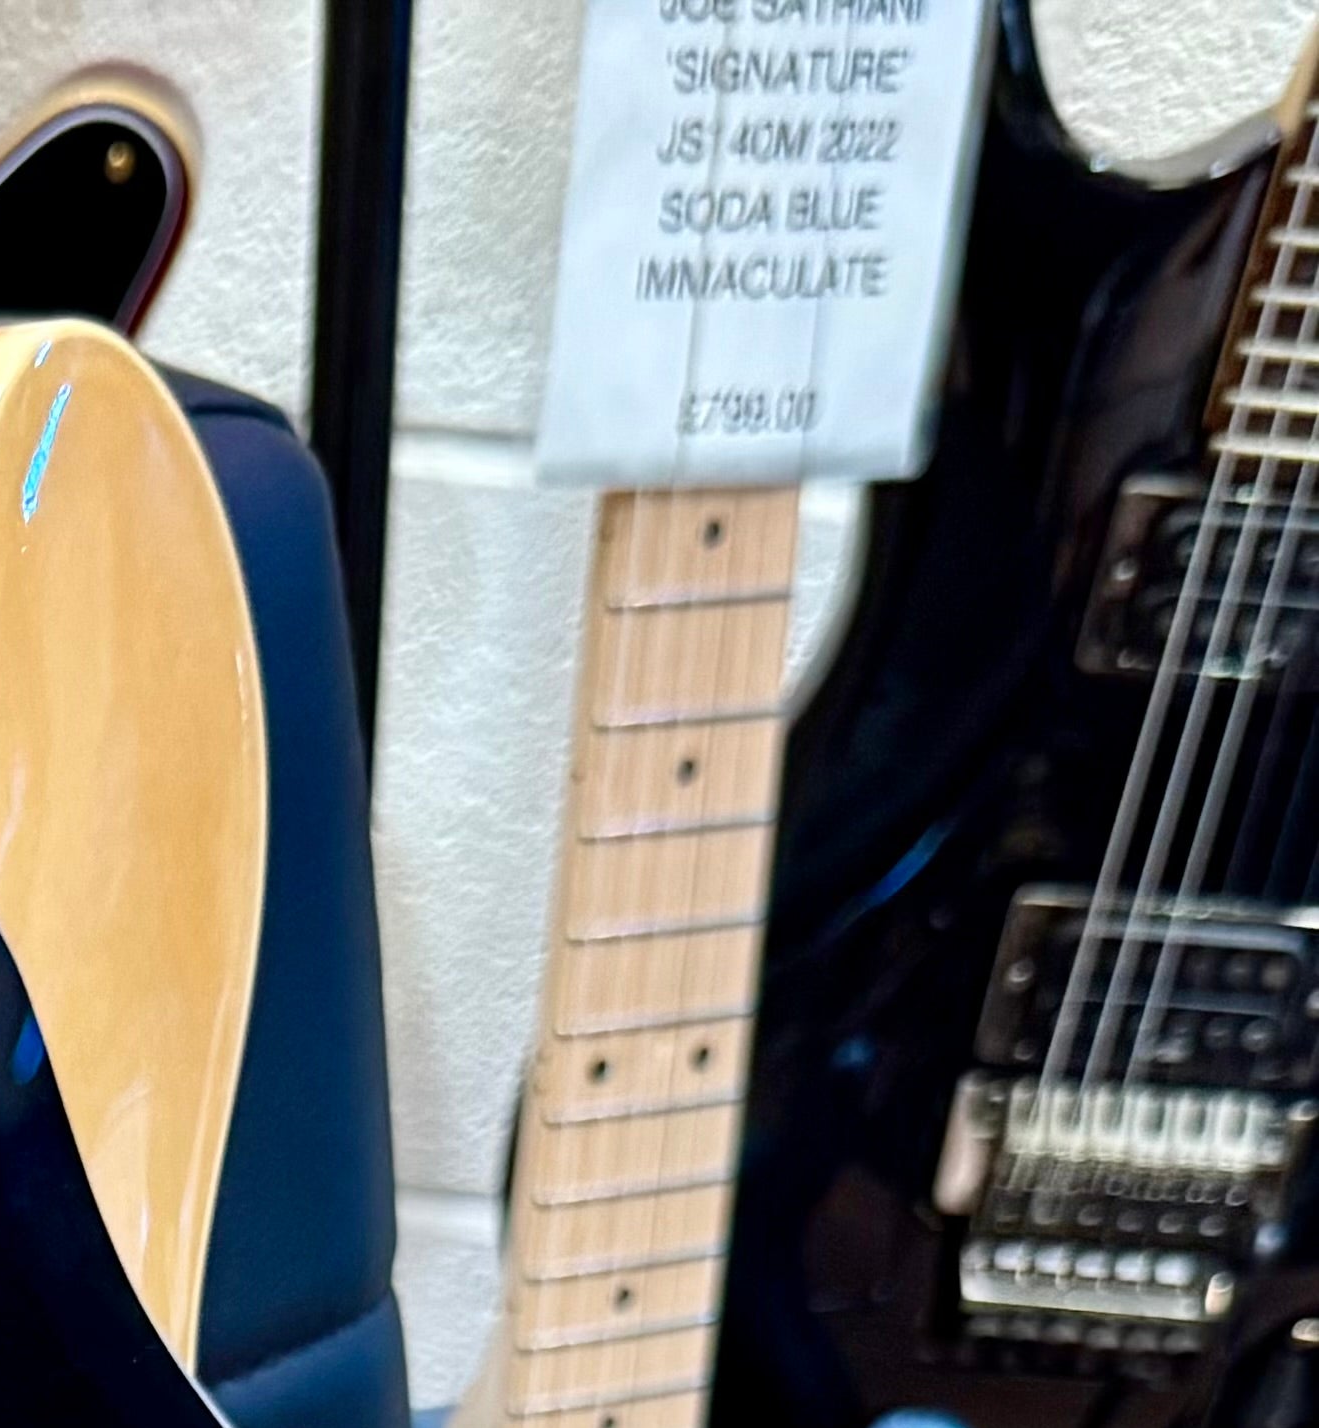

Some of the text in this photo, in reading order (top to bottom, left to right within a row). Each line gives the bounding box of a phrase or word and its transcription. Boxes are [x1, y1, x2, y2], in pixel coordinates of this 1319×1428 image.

[817, 115, 903, 163] 2022
[659, 186, 886, 234] SODA BLUE
[635, 252, 892, 302] IMMACULATE
